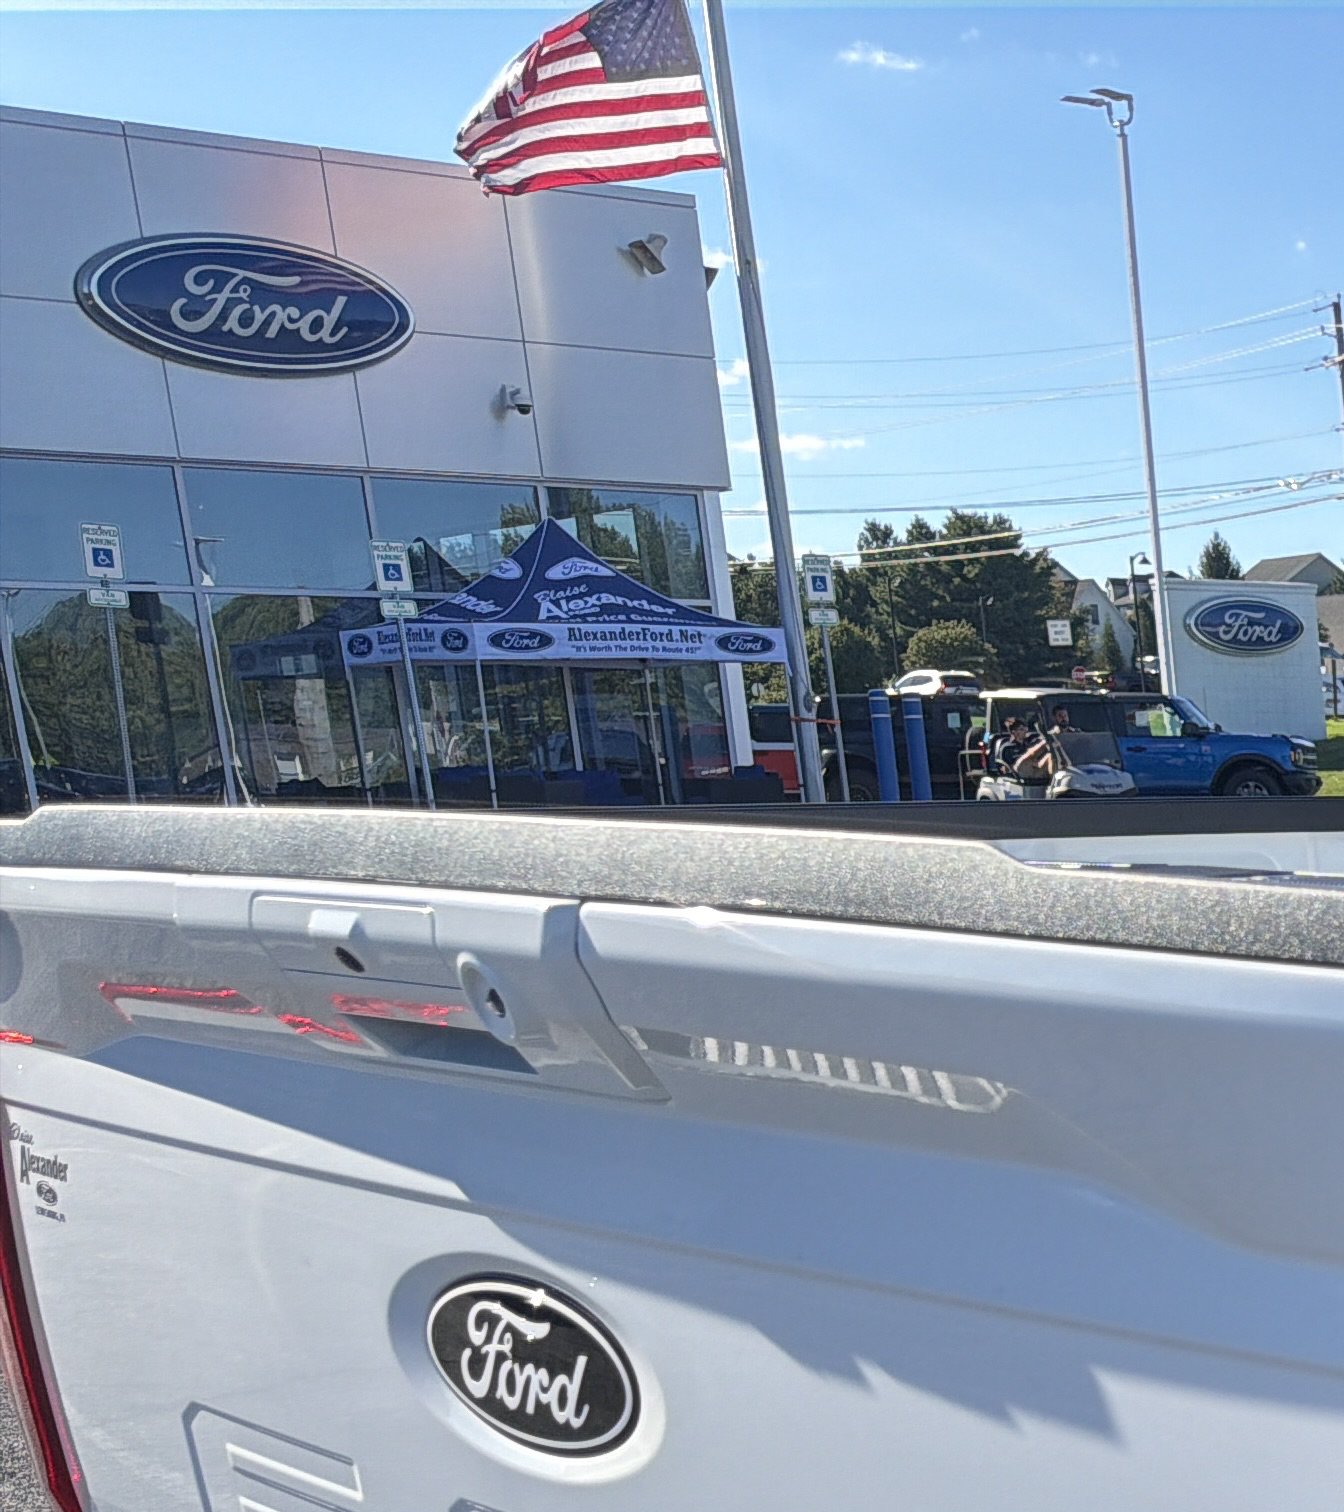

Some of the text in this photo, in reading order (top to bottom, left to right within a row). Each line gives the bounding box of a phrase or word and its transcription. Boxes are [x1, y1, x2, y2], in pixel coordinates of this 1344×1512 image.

[170, 264, 349, 344] Ford
[82, 527, 118, 538] RESERVED
[86, 537, 118, 547] PARKING
[376, 553, 404, 561] PARKING
[538, 592, 676, 620] Alexander
[567, 626, 703, 644] AlexanderFord.Net
[1218, 609, 1282, 643] Ford
[502, 631, 541, 650] Ford
[589, 645, 613, 653] Worth
[651, 645, 660, 653] To
[727, 635, 763, 651] Ford
[20, 1145, 69, 1185] Alexander
[460, 1300, 590, 1429] Ford
